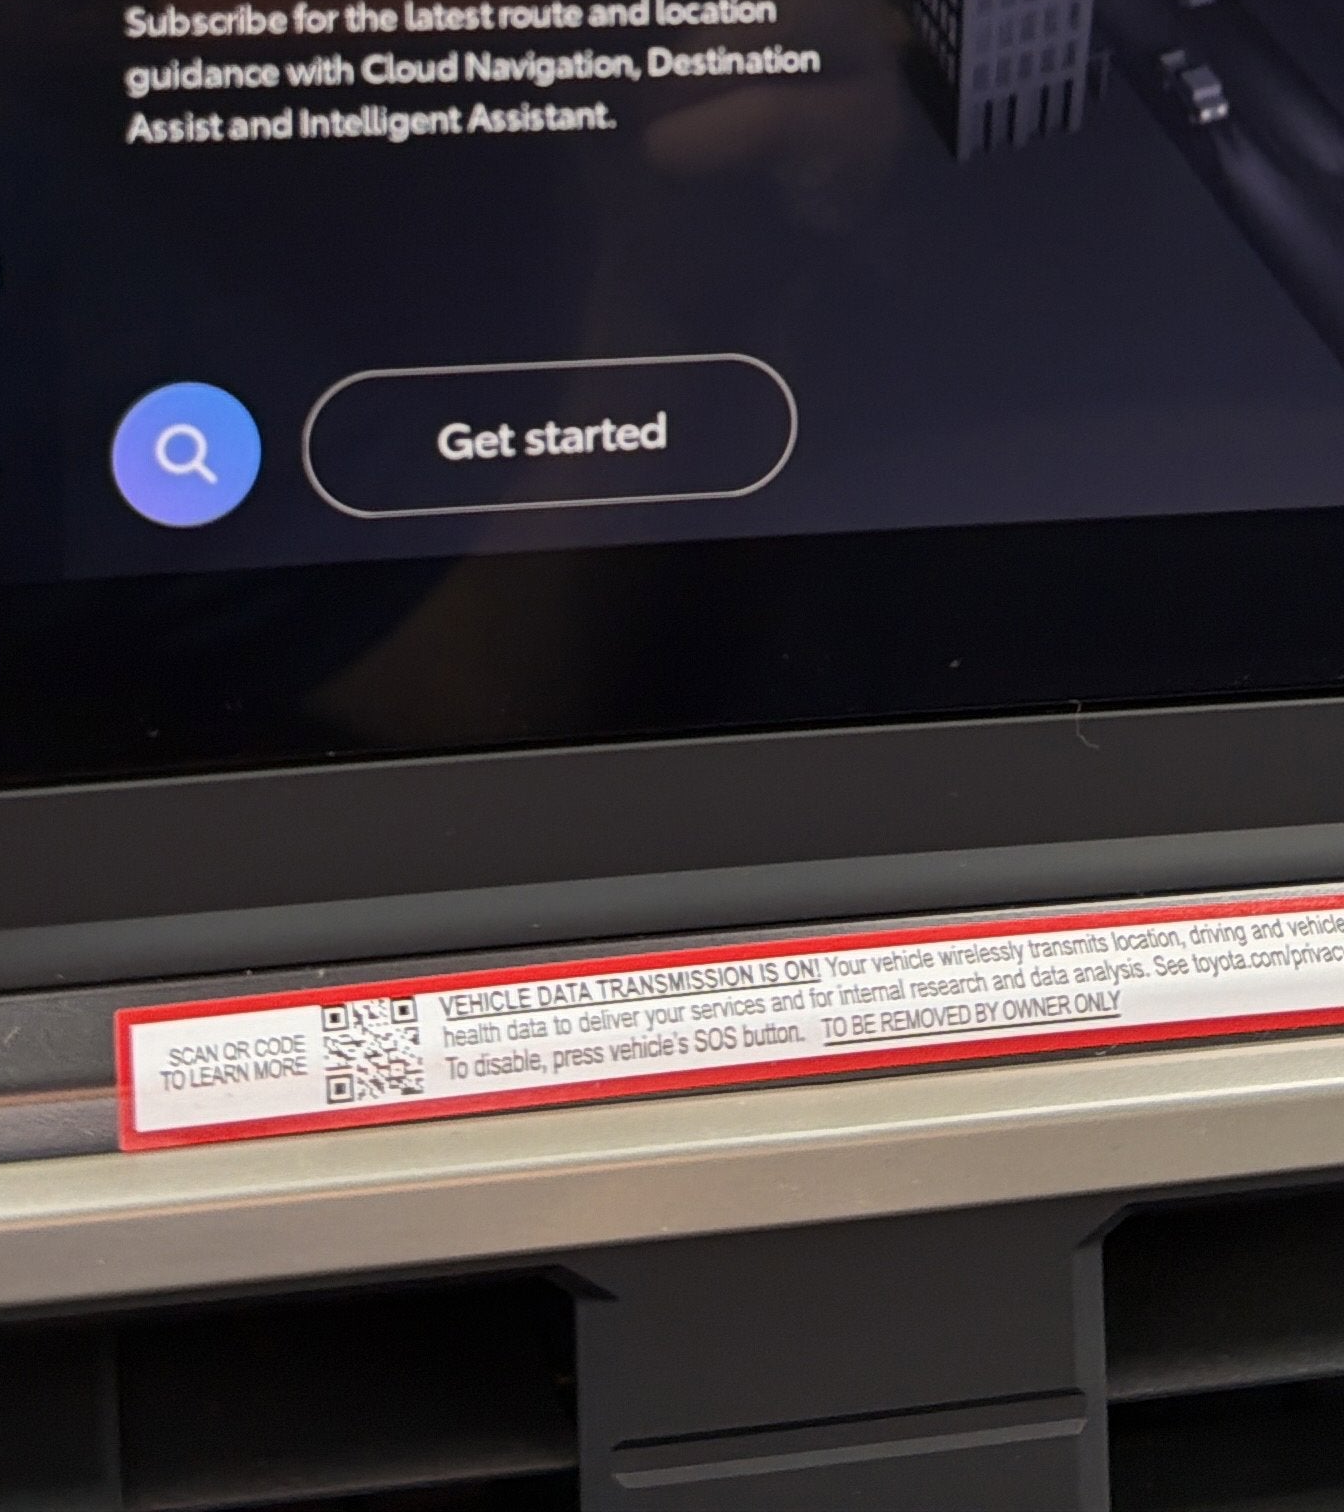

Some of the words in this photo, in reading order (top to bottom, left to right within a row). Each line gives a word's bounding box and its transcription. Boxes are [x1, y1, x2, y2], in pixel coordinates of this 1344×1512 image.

[124, 6, 287, 40] Subscribe
[293, 3, 339, 34] for
[346, 1, 398, 33] the
[405, 0, 494, 31] latest
[499, 0, 582, 30] route
[125, 59, 280, 97] guidance
[286, 56, 354, 87] with
[361, 54, 457, 85] Cloud
[464, 50, 642, 85] Navigation,
[648, 45, 821, 79] Destination
[127, 111, 222, 144] Assist
[229, 108, 292, 140] and
[299, 106, 461, 143] Intelligent
[467, 101, 617, 135] Assistant.
[437, 419, 517, 461] Get
[525, 411, 667, 457] started
[439, 988, 532, 1017] VEHICLE
[538, 982, 591, 1007] DATA
[596, 965, 754, 1001] TRANSMISSION
[759, 962, 778, 982] IS
[785, 958, 821, 980] ON!
[825, 956, 866, 978] Your
[872, 948, 934, 973] vehicle
[937, 940, 1023, 967] wirelessly
[1028, 933, 1108, 959] transmits
[1111, 929, 1185, 952] location,
[1189, 923, 1247, 947] driving
[1251, 918, 1284, 940] and
[442, 1022, 502, 1049] health
[507, 1018, 547, 1041] data
[554, 1015, 572, 1036] to
[579, 1009, 638, 1034] deliver
[645, 1006, 685, 1032] your
[691, 996, 766, 1020] services
[771, 990, 803, 1014] and
[809, 987, 833, 1009] for
[840, 978, 905, 1006] internal
[910, 973, 988, 999] research
[993, 968, 1026, 991] and
[1029, 964, 1069, 987] data
[1074, 957, 1150, 986] analysis.
[1155, 955, 1189, 977] See
[169, 1044, 218, 1067] SCAN
[224, 1039, 250, 1060] QR
[255, 1035, 306, 1059] CODE
[445, 1056, 468, 1080] To
[474, 1048, 547, 1076] disable,
[552, 1044, 604, 1073] press
[610, 1031, 689, 1062] vehicle's
[694, 1025, 737, 1050] SOS
[742, 1022, 805, 1048] button.
[821, 1016, 847, 1039] TO
[851, 1013, 876, 1035] BE
[880, 1004, 971, 1031] REMOVED
[975, 1001, 998, 1023] BY
[1002, 994, 1070, 1020] OWNER
[1073, 989, 1121, 1014] ONLY
[160, 1070, 186, 1091] TO
[190, 1063, 252, 1088] LEARN
[255, 1057, 308, 1080] MORE
